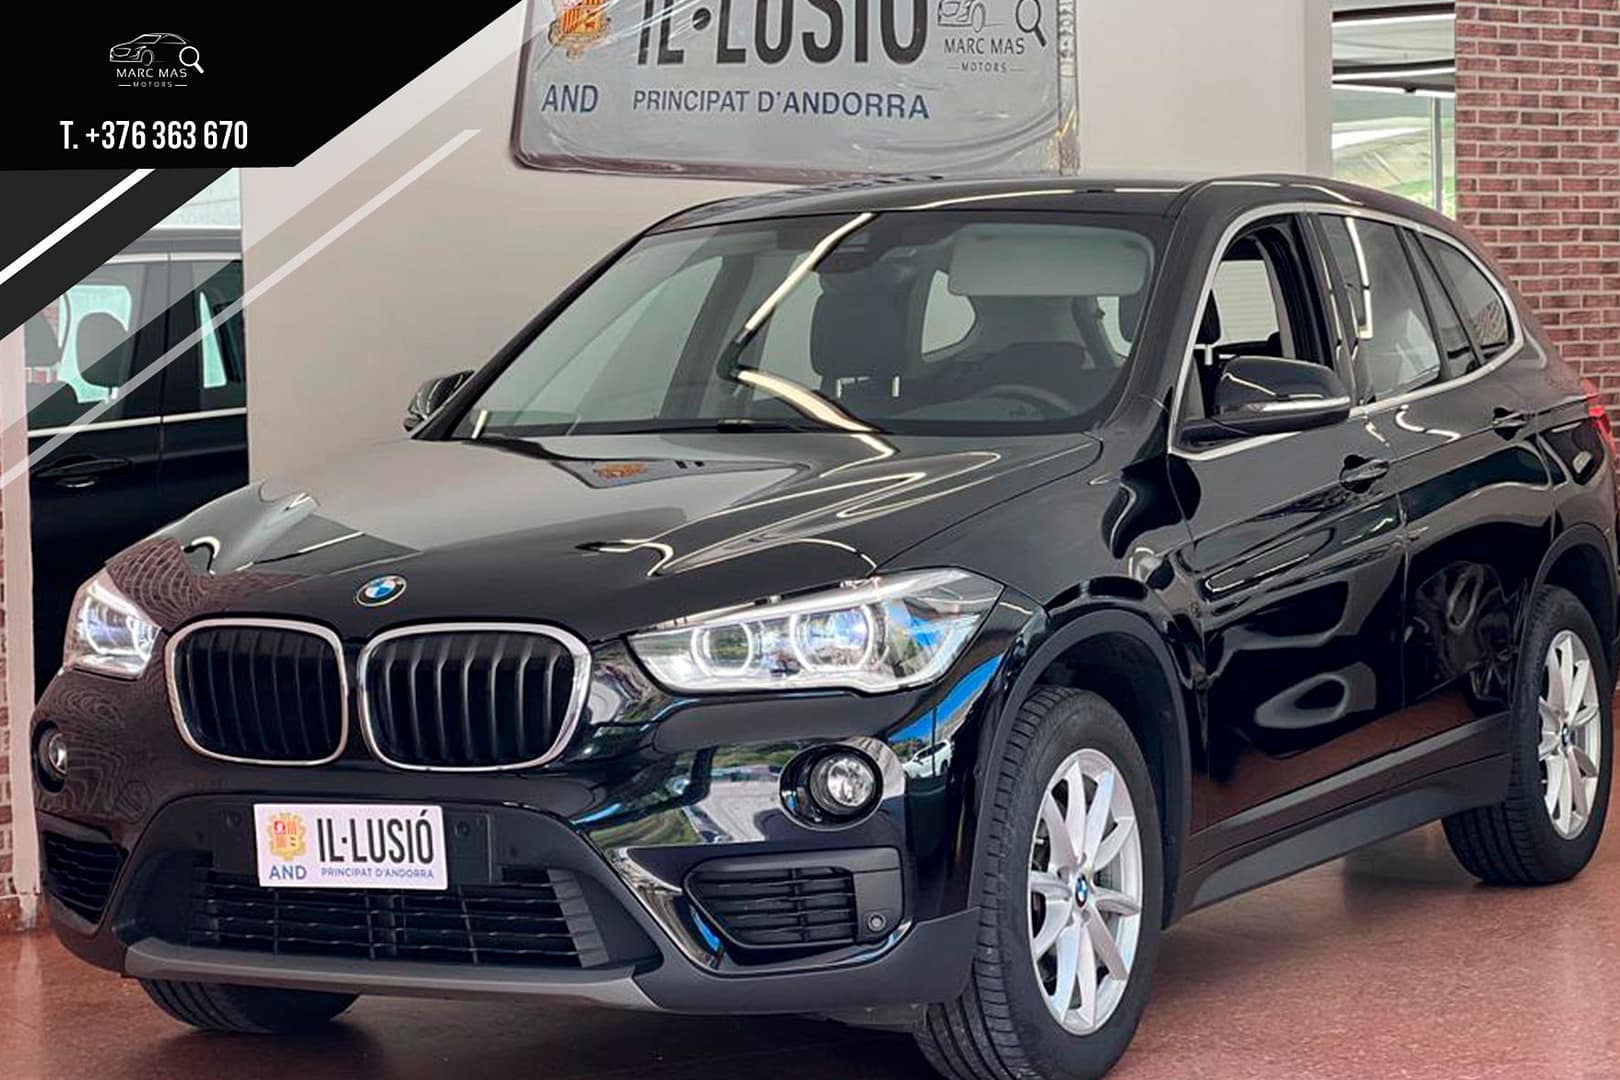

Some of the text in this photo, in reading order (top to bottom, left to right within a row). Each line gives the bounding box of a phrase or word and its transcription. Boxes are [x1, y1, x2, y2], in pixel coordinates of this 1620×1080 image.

[944, 37, 1025, 55] MARC MAS
[961, 62, 1007, 73] MOTORS
[541, 83, 599, 113] AND
[632, 90, 930, 120] PRINCIPAT D'ANDORRA
[316, 809, 434, 864] IL·LUSIÓ
[269, 865, 307, 881] AND
[321, 866, 435, 880] PRINCIPAT D'ANDORRA
